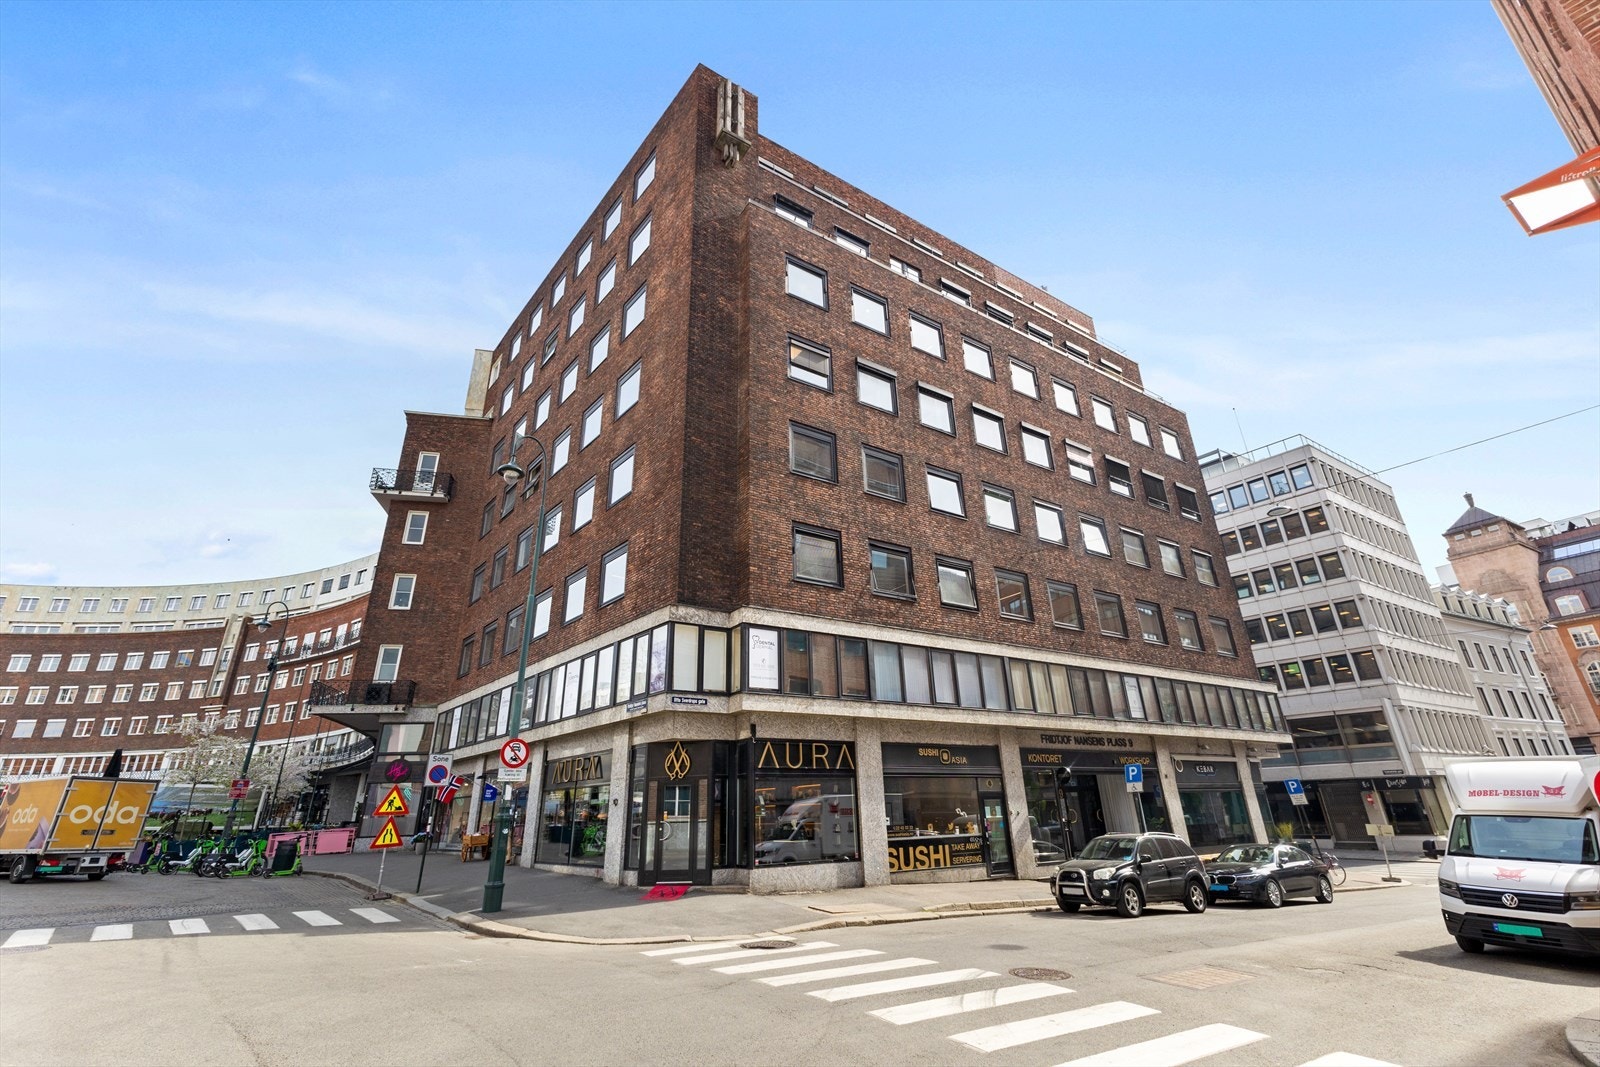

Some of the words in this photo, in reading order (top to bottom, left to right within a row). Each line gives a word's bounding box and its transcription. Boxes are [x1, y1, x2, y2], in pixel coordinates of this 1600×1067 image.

[1040, 734, 1072, 745] FRIDTJOF
[1074, 735, 1105, 747] NANSENS
[1107, 737, 1127, 747] PLASS
[1128, 738, 1133, 748] 9
[758, 741, 855, 770] AURA
[918, 748, 939, 757] SUSHI
[432, 755, 450, 763] Sone
[951, 756, 968, 764] ASIA
[1028, 753, 1063, 764] KONTORET
[1119, 756, 1150, 765] WORKSHOP
[1128, 766, 1137, 780] P
[1287, 781, 1298, 793] P
[1468, 789, 1540, 797] MØBEL-DESIGN
[12, 803, 39, 825] oda
[69, 801, 140, 825] oda
[951, 843, 965, 851] TAKE
[966, 842, 980, 850] AWAY
[888, 844, 951, 873] SUSHI
[952, 854, 983, 865] SERVERING
